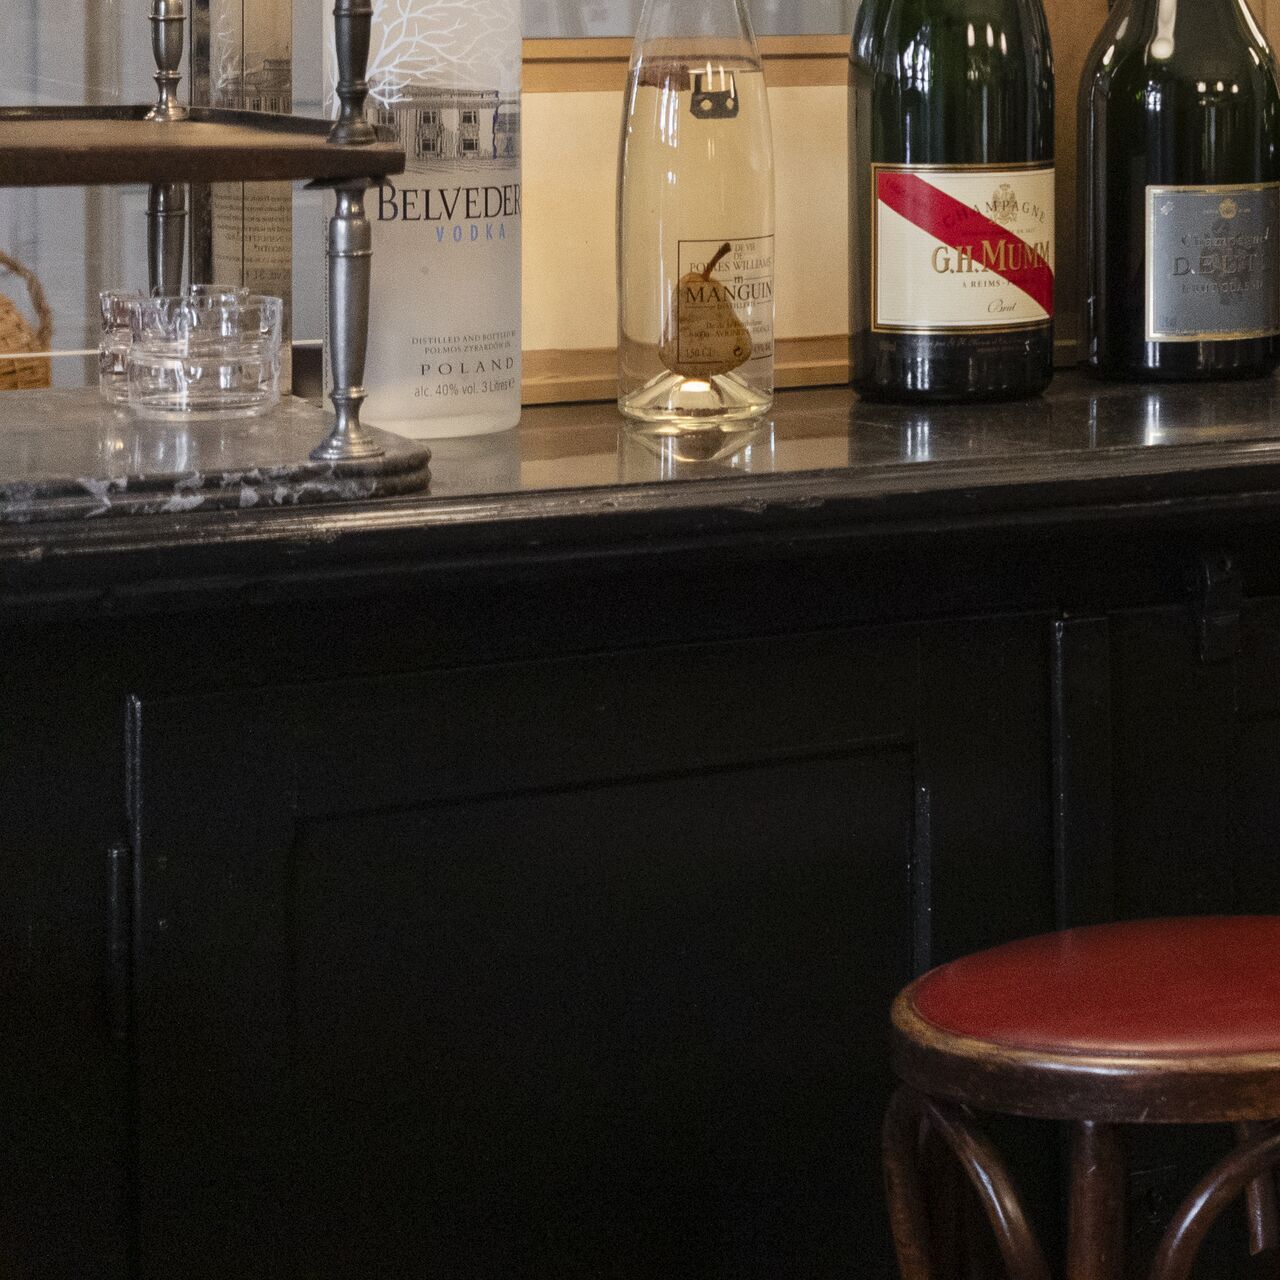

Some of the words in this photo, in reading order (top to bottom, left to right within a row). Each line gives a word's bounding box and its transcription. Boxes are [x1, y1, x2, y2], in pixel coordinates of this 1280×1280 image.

[436, 223, 506, 242] VODKA
[686, 281, 772, 303] MANGUIN
[970, 279, 1001, 288] REIMS
[987, 298, 1017, 314] Brut
[411, 336, 460, 345] DISTILLED
[463, 334, 481, 344] AND
[420, 357, 514, 376] POLAND
[414, 385, 433, 398] alc.
[435, 383, 459, 397] 40%
[462, 382, 479, 395] vol.
[481, 381, 488, 394] 3
